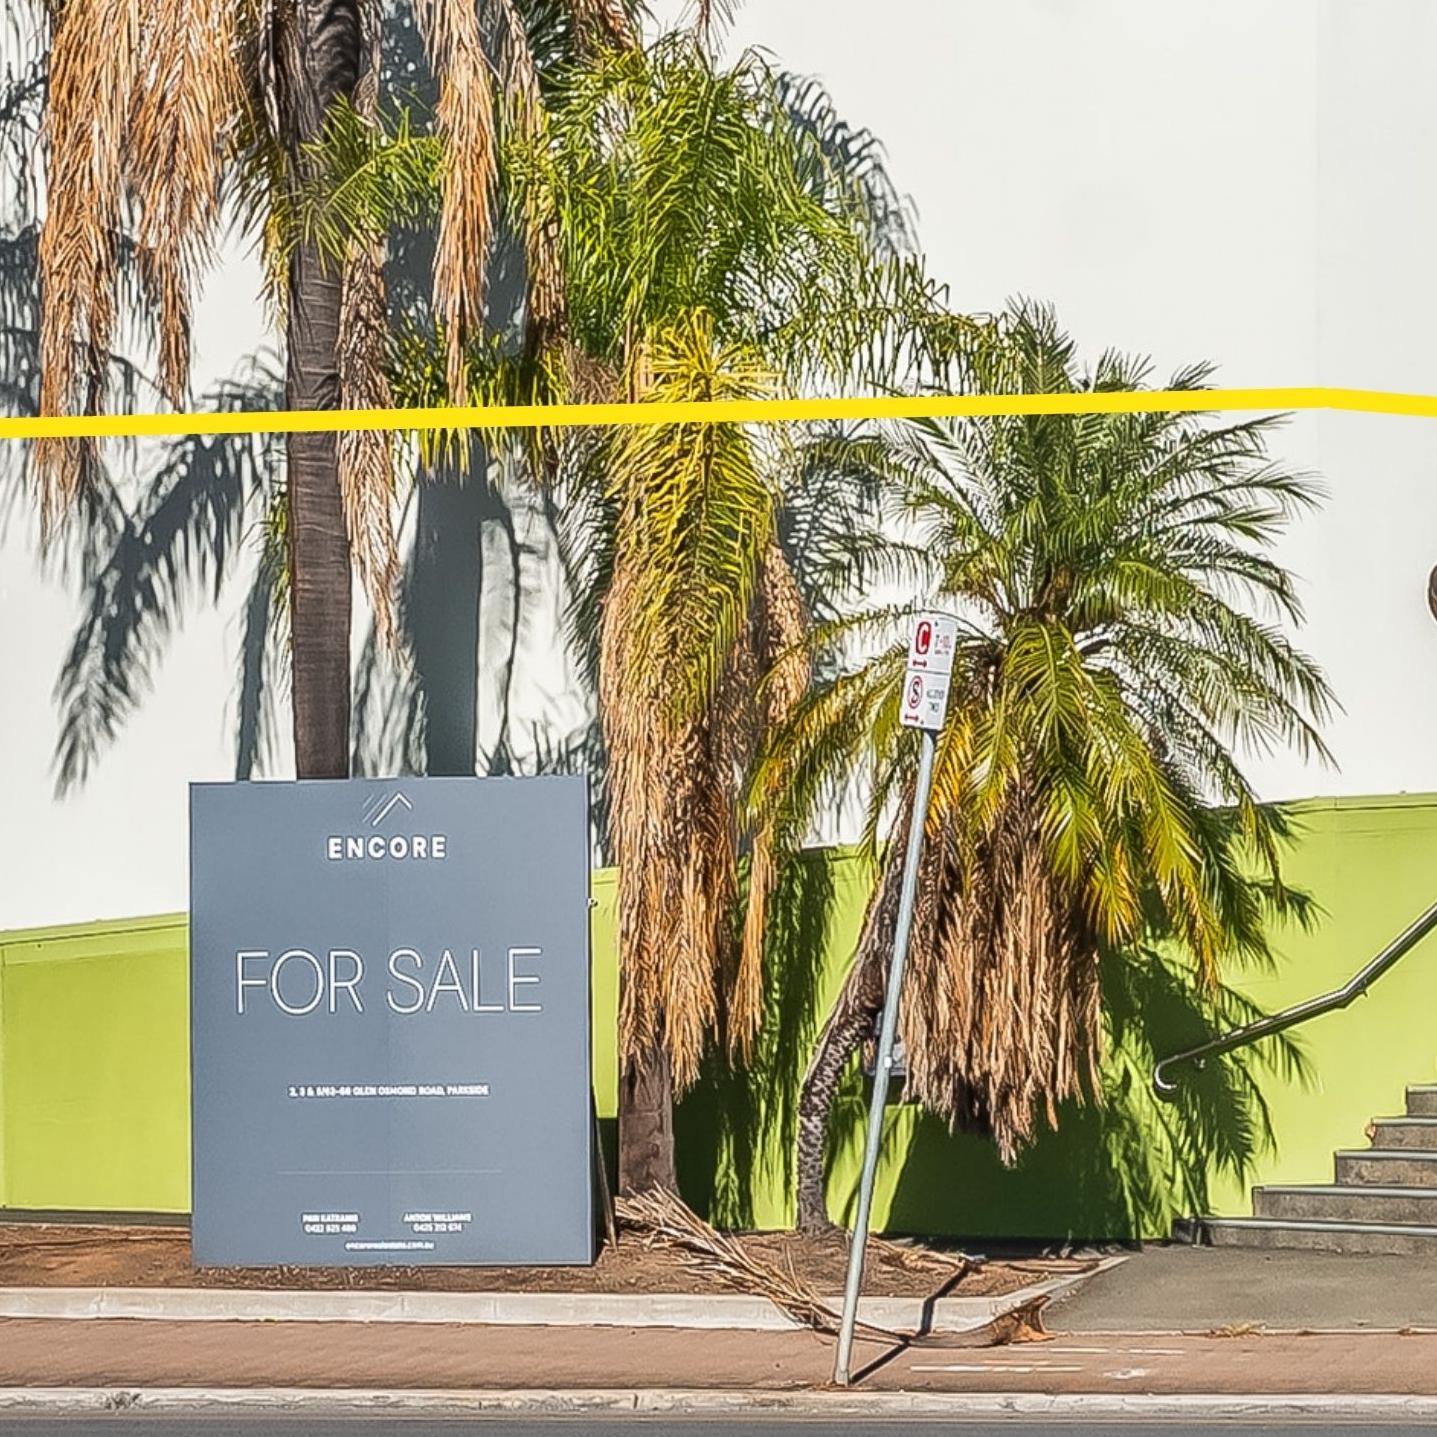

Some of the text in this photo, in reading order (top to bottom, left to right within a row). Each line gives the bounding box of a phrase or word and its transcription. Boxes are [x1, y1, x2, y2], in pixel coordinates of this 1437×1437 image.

[327, 835, 447, 860] ENCORE
[236, 948, 542, 1014] FOR SALE
